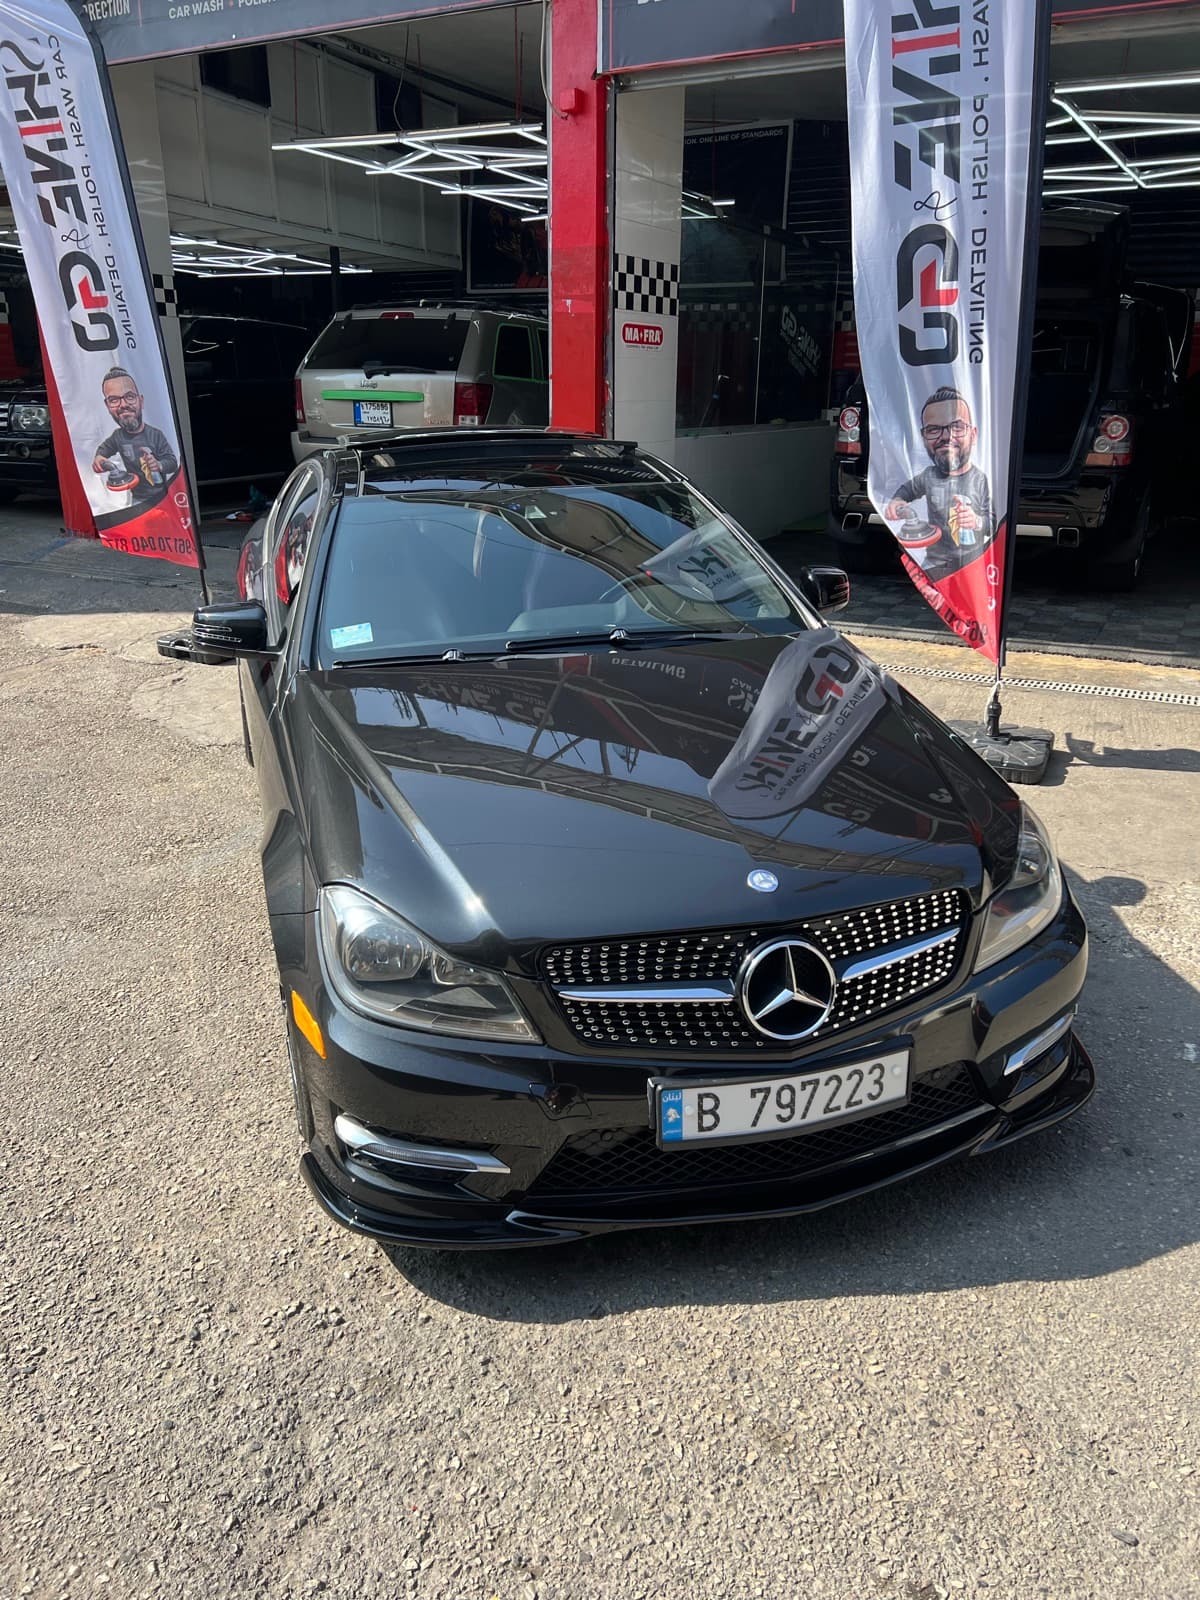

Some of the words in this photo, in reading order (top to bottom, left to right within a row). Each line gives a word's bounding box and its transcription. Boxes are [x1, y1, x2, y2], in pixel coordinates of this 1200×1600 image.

[168, 5, 190, 19] CAR
[192, 0, 224, 15] WASH
[697, 1092, 721, 1132] B
[750, 1063, 885, 1128] 797223
